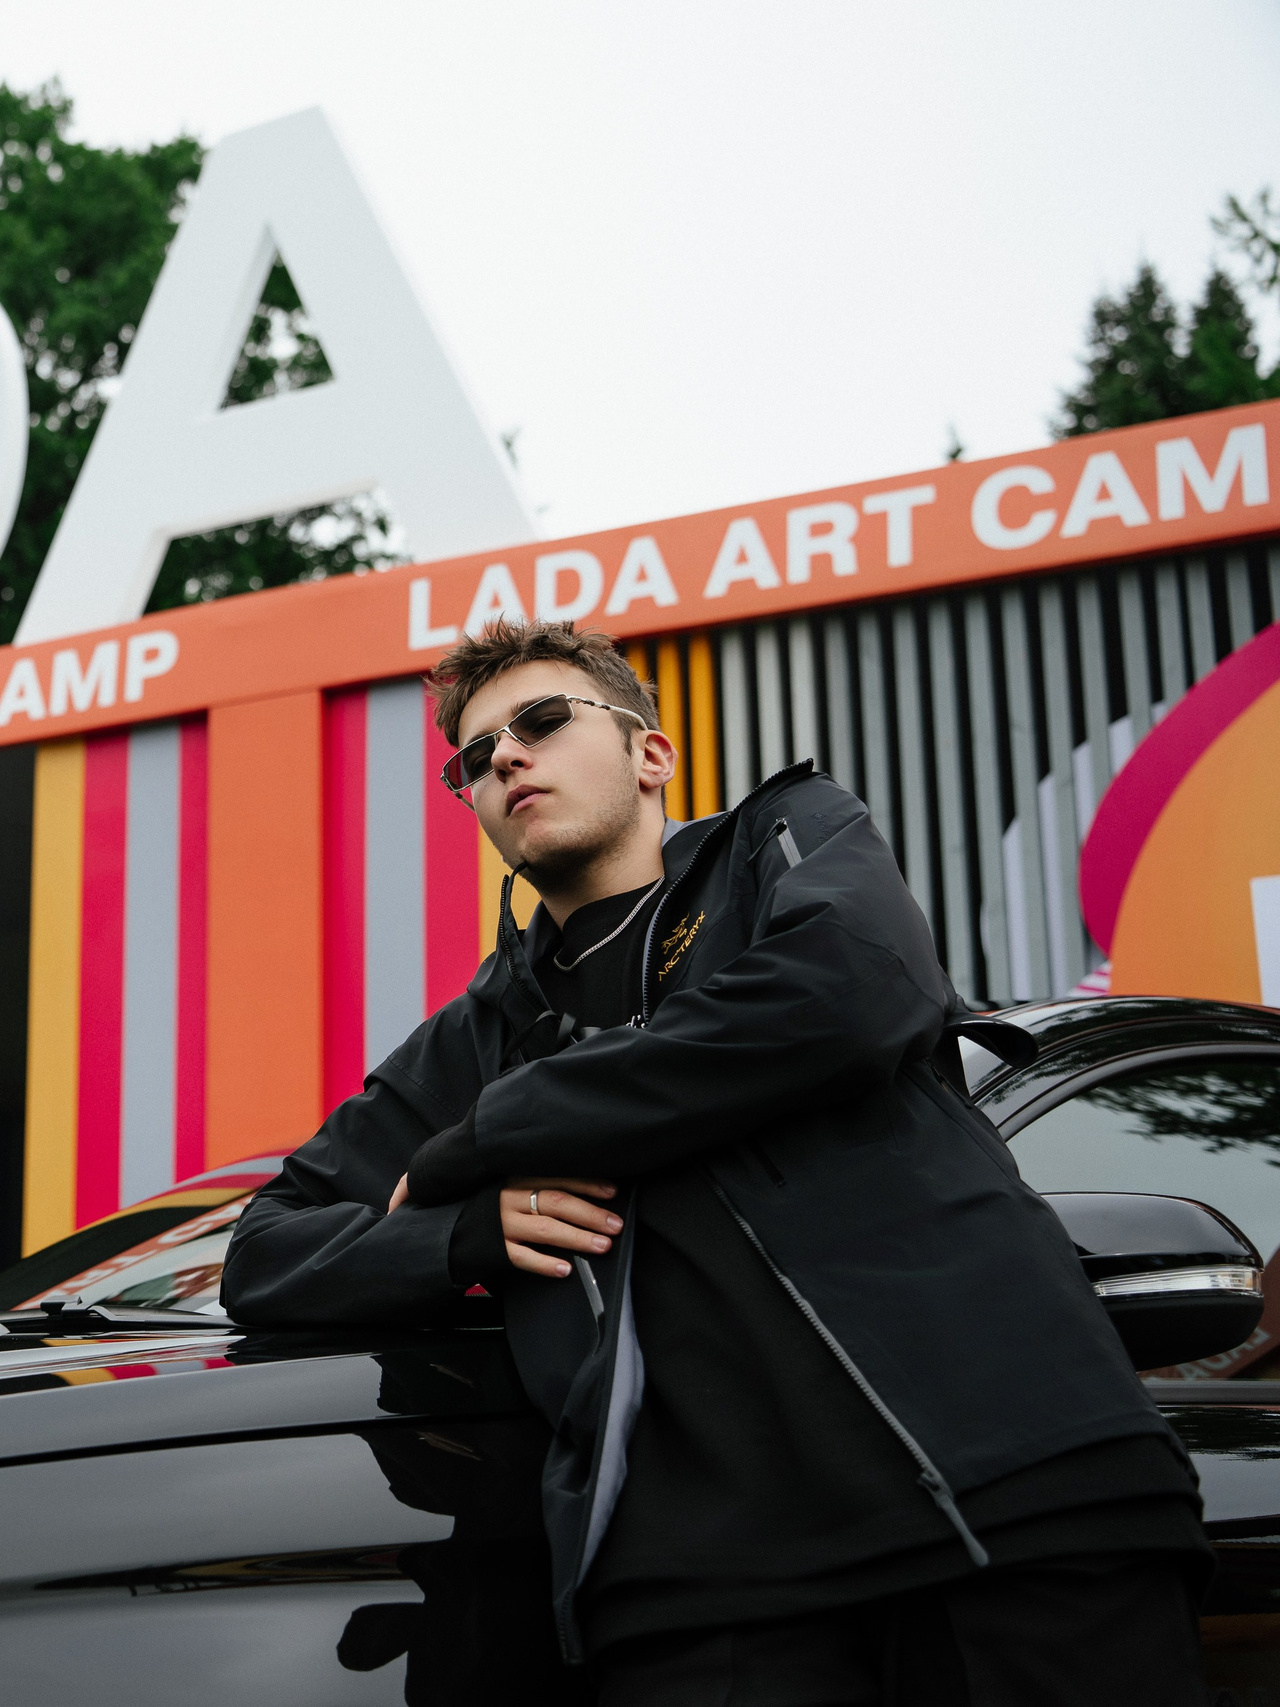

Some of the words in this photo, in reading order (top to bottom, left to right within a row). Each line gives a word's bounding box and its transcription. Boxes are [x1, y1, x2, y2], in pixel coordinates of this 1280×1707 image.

[407, 535, 680, 651] LADA
[703, 484, 938, 598] ART
[970, 422, 1271, 551] CAM
